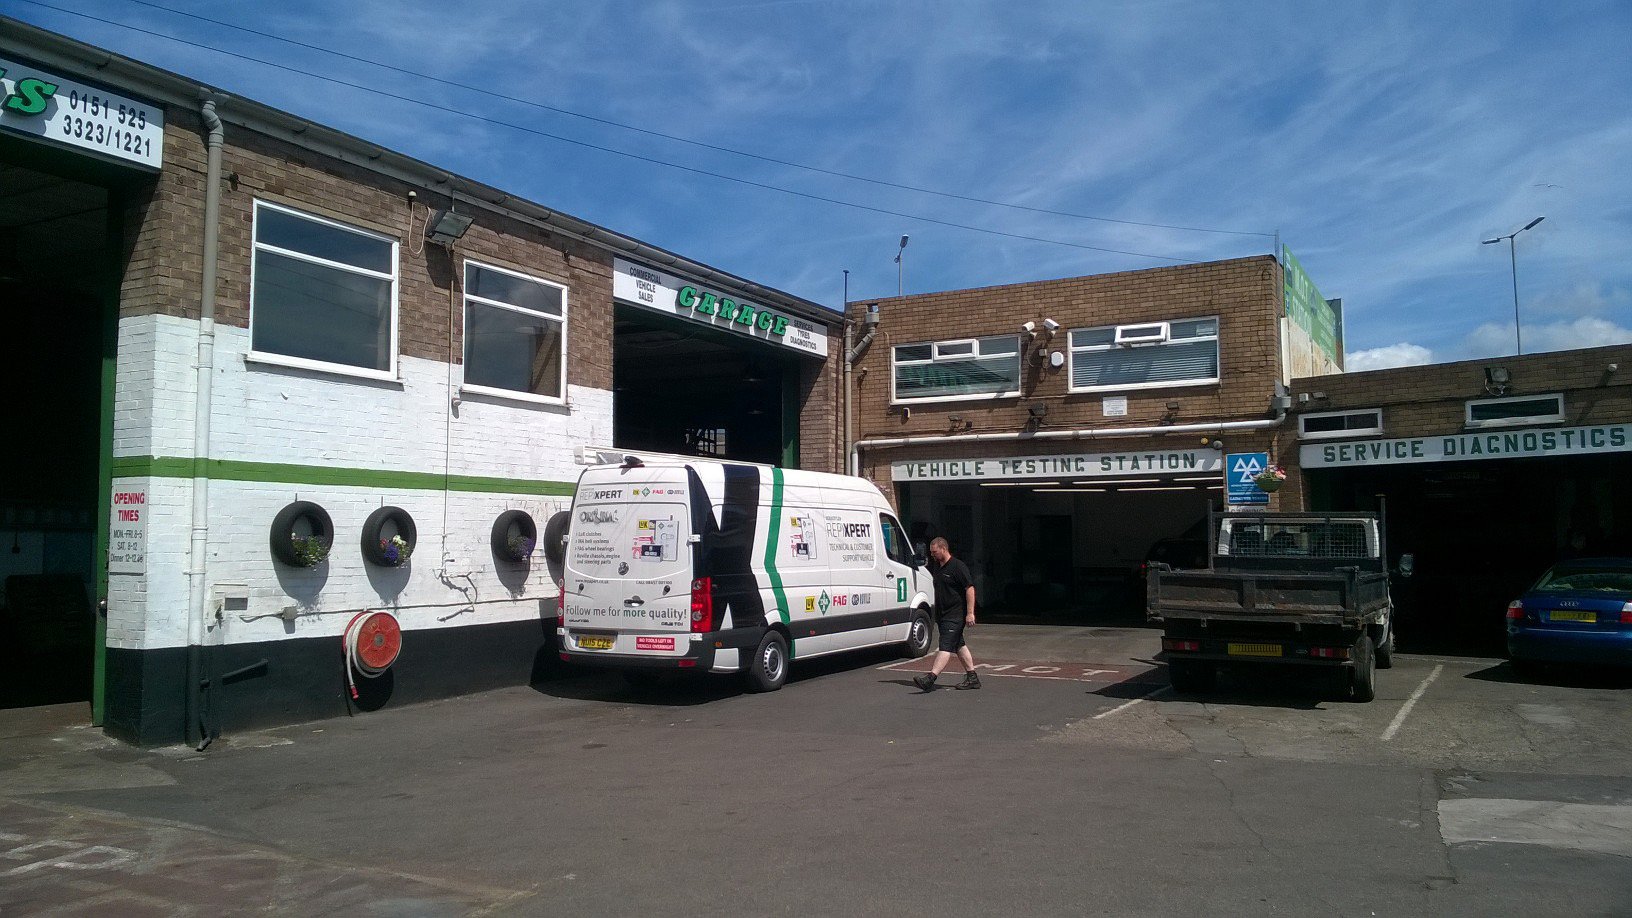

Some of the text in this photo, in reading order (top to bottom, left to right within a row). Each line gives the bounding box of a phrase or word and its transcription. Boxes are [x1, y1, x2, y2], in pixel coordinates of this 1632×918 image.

[0, 66, 60, 117] S
[69, 89, 146, 131] 0151 525
[63, 114, 151, 158] 3323/1221
[629, 266, 662, 285] COMMERCIAL
[635, 279, 656, 293] VEHICLE
[638, 290, 654, 303] SALES
[678, 285, 789, 336] GARAGE
[793, 319, 814, 333] SERVICES
[789, 335, 817, 350] DIAGNOSTICS
[797, 329, 811, 340] TYRES
[1323, 427, 1626, 463] SERVICE DIAGNOSTICS
[906, 452, 1195, 478] VEHICLE TESTING STATION
[113, 492, 145, 505] OPENING
[117, 509, 140, 522] TIMES
[832, 595, 847, 606] FAG
[566, 604, 687, 621] Follow me for more quality!
